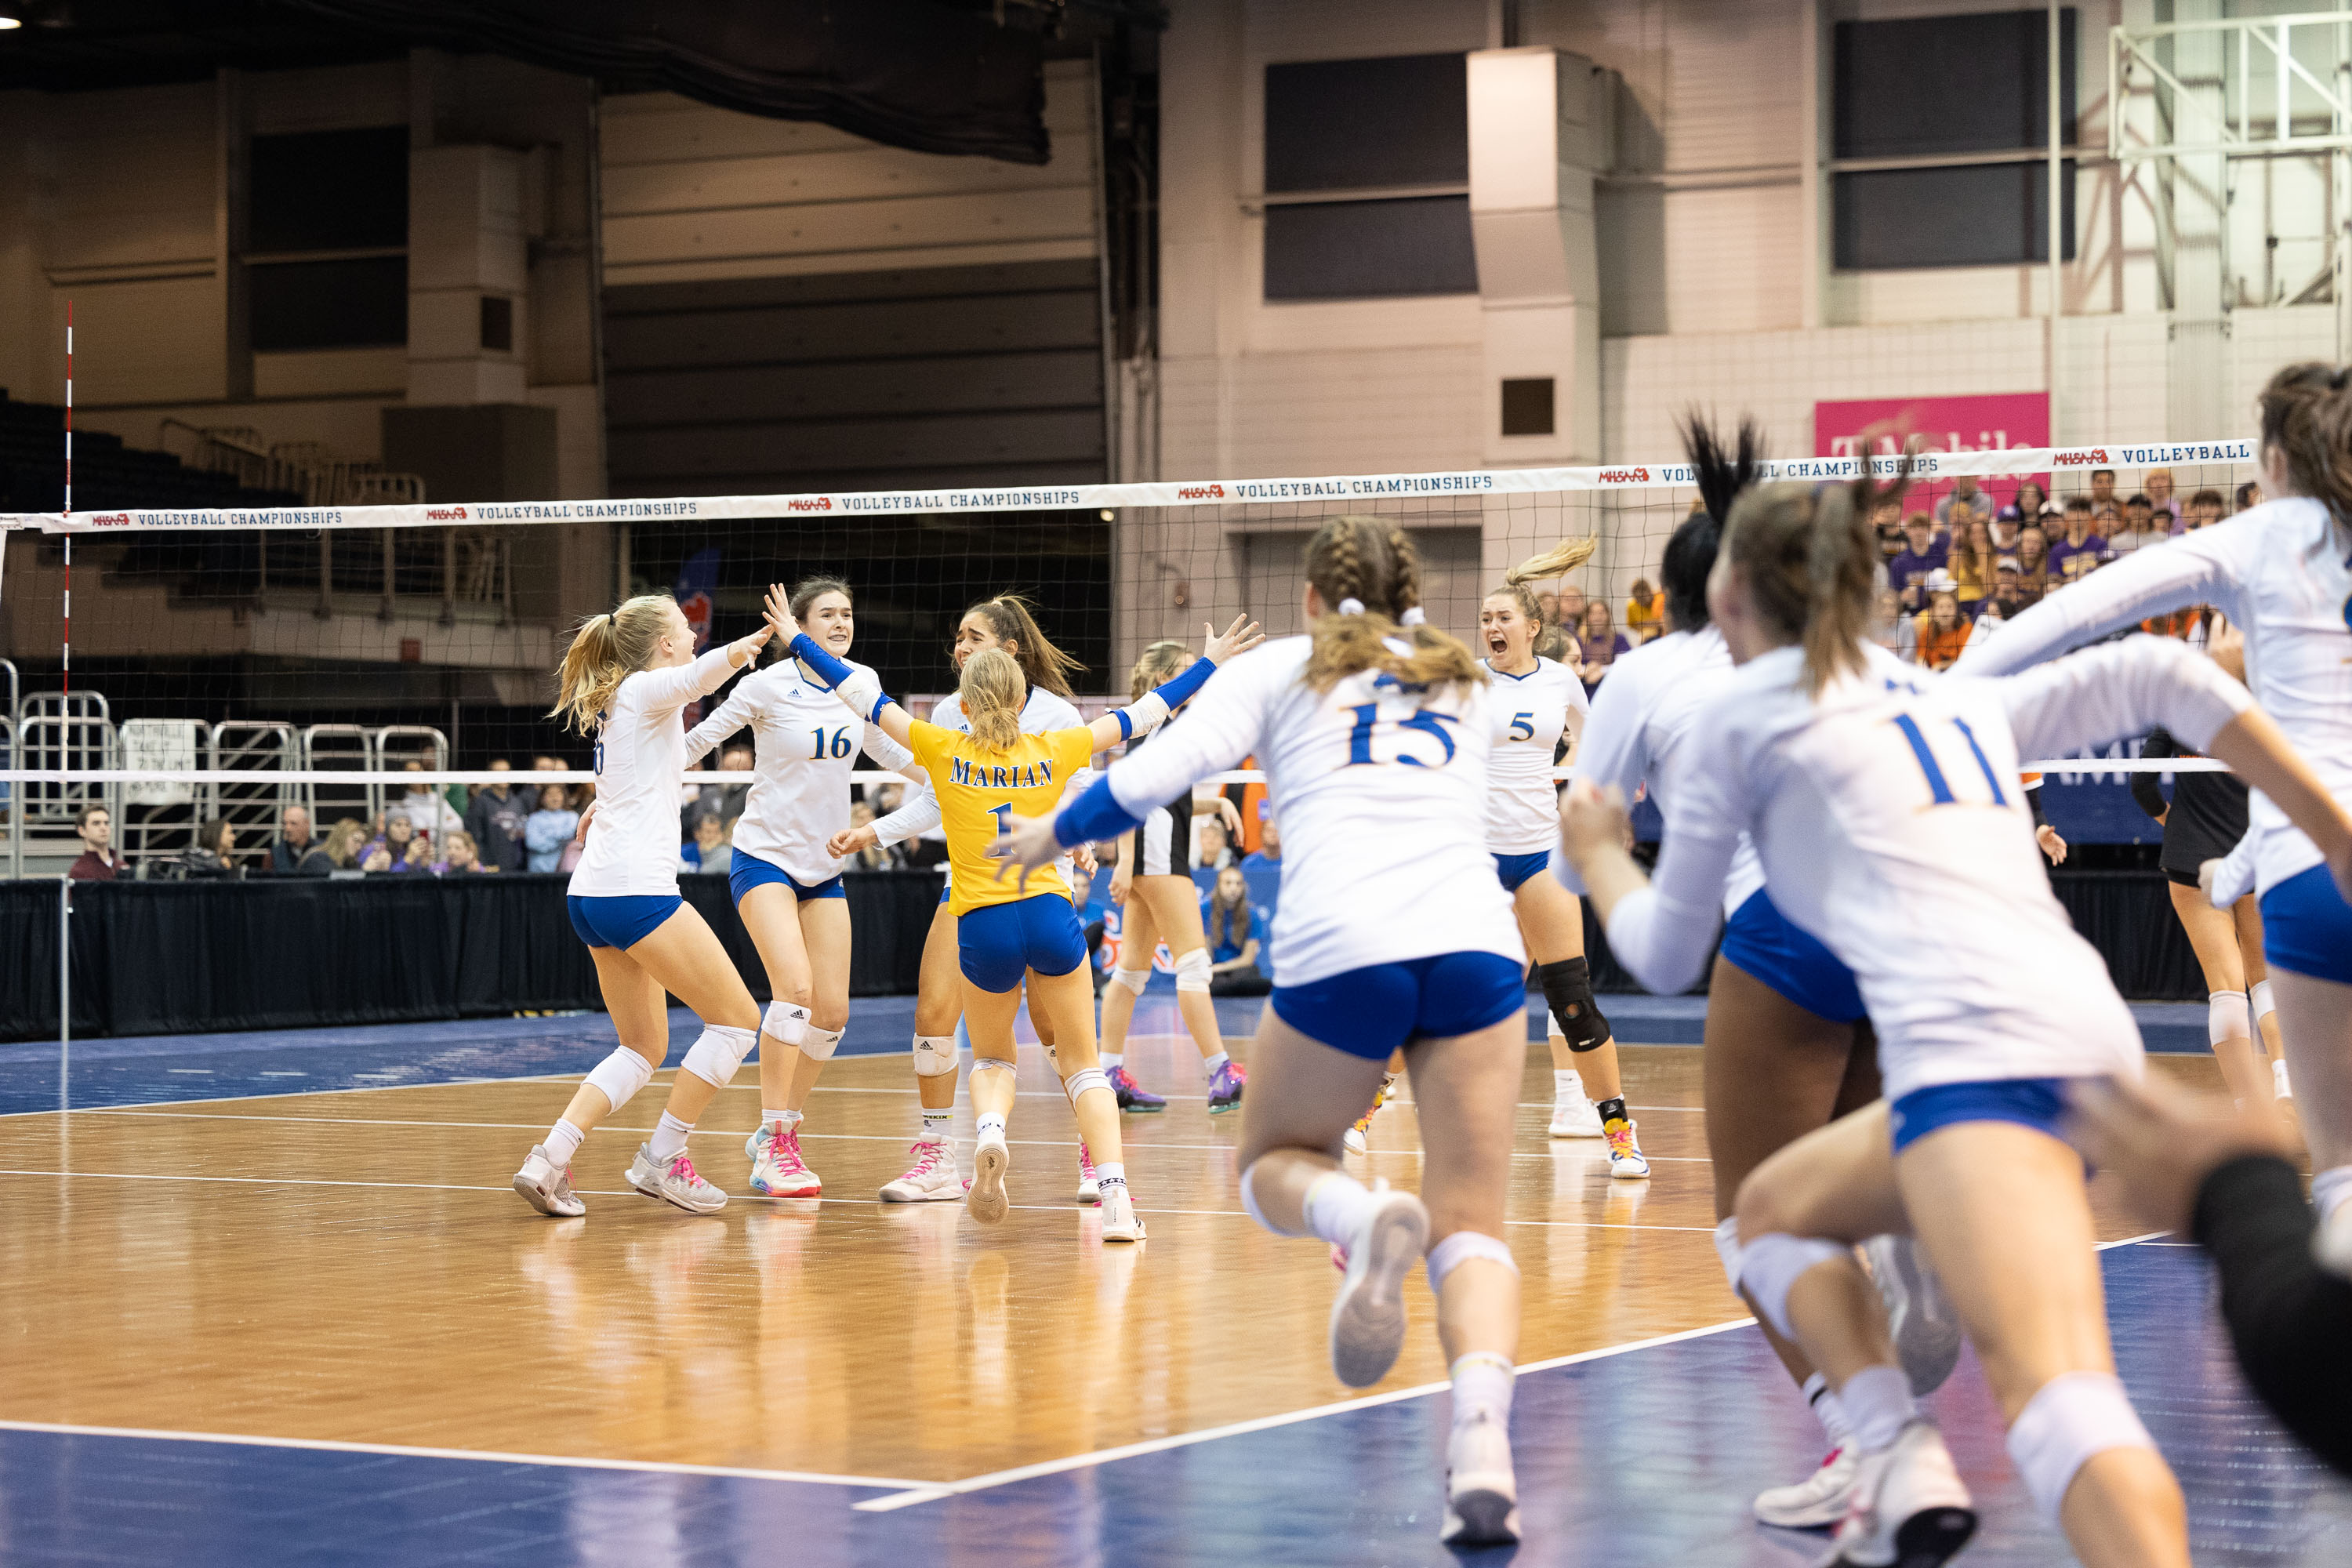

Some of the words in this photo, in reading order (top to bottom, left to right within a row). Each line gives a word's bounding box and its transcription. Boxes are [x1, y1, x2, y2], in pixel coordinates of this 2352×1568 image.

[2122, 445, 2249, 463] VOLLEYBALL
[1663, 460, 1780, 481] VOLLL
[1236, 479, 1345, 498] VOLLEYBALL
[1353, 476, 1492, 493] CHAMPIONSHIPS
[477, 505, 571, 519] VOLLEYBALL
[577, 502, 697, 517] CHAMPIONSHIPS
[842, 495, 942, 510] VOLLEYBALL
[950, 491, 1080, 507] CHAMPIONSHIPS
[138, 512, 226, 525] VOLLEYBALL
[230, 511, 343, 525] CHAMPIONSHIPS
[1336, 702, 1461, 770] 15
[1508, 712, 1534, 741] 5
[808, 725, 851, 760] 16
[949, 756, 1054, 788] MARIAN
[1877, 712, 2017, 812] 11
[986, 801, 1017, 858] 1
